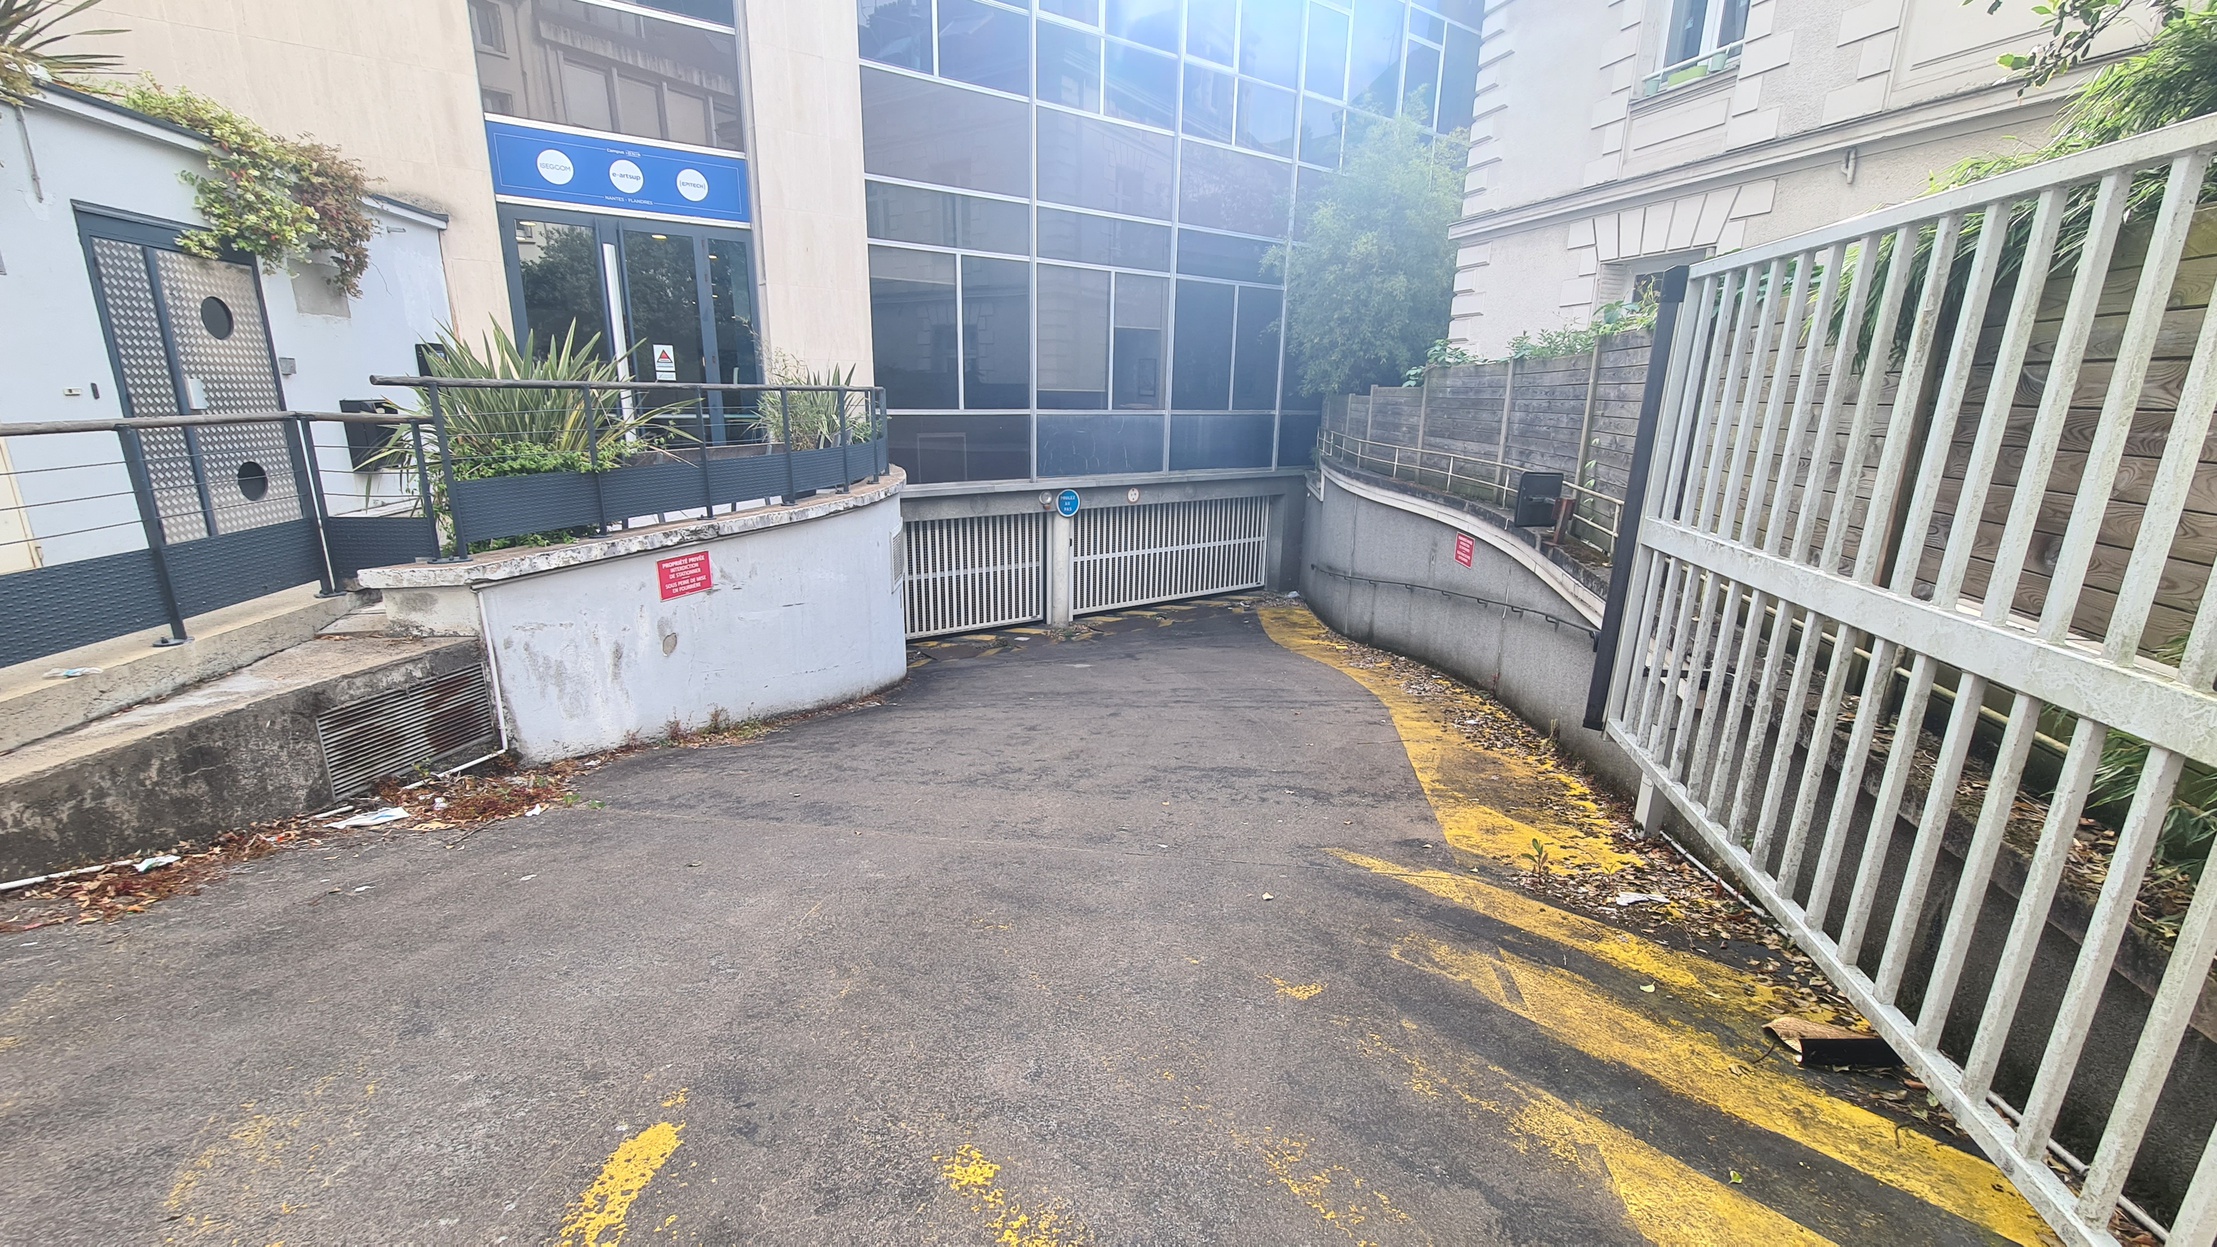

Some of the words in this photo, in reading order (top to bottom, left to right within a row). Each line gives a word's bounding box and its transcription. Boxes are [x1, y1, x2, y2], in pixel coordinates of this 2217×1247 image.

[612, 172, 641, 181] e-artsup
[662, 558, 688, 569] PROPRIÉTÉ
[688, 555, 705, 563] PRIVÉE
[669, 563, 699, 573] INTERDICTION
[676, 568, 701, 577] STATIONNER
